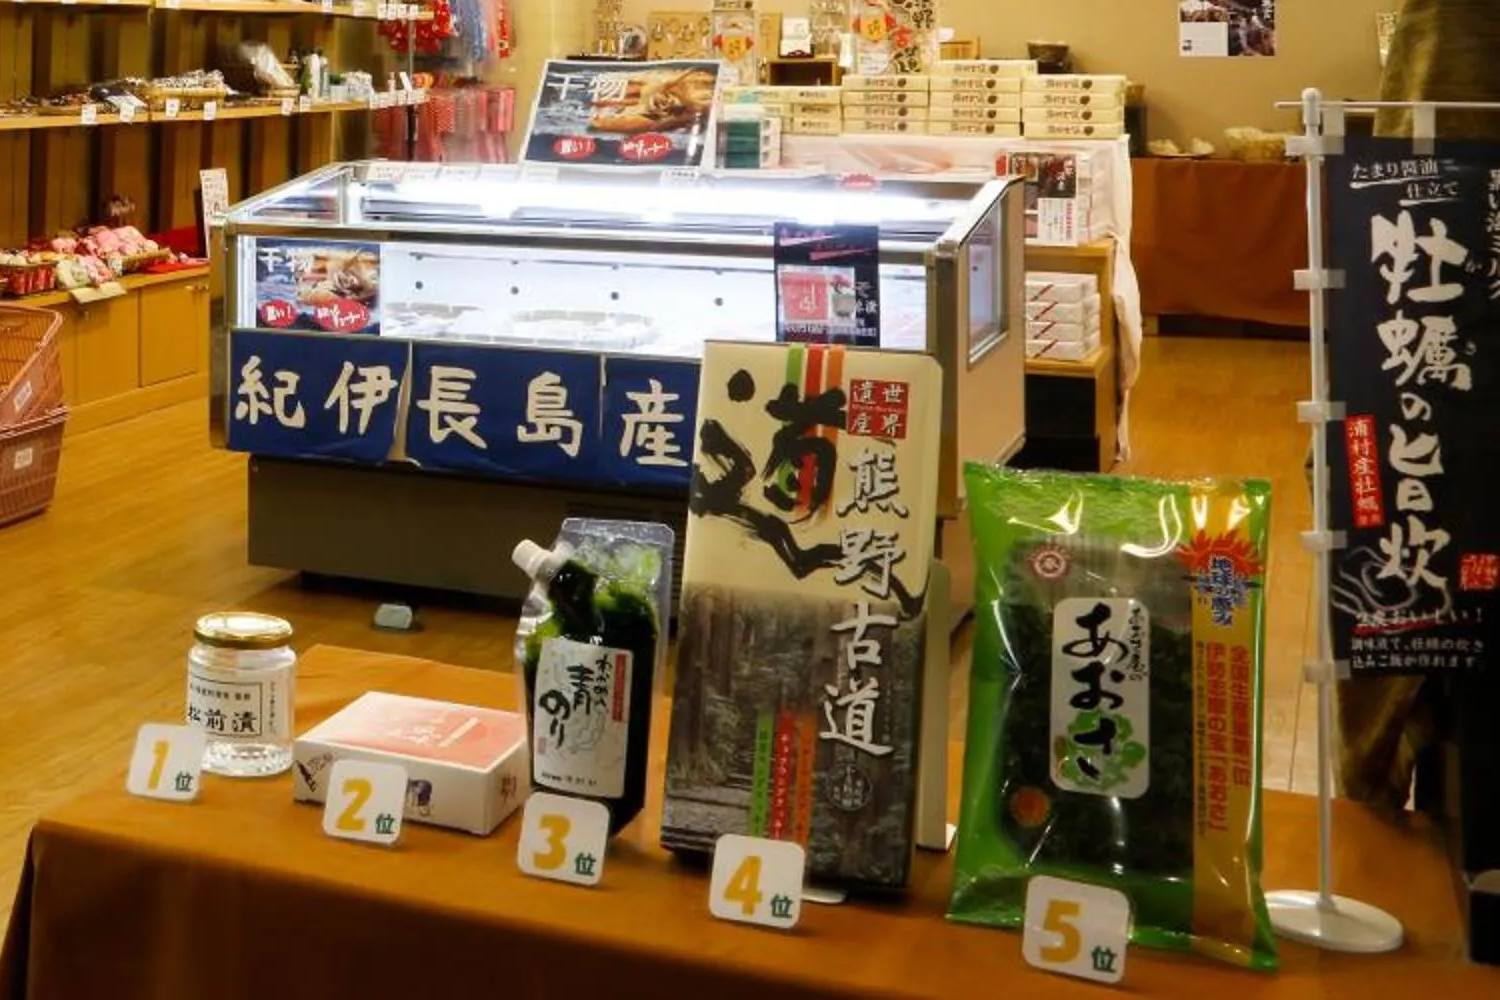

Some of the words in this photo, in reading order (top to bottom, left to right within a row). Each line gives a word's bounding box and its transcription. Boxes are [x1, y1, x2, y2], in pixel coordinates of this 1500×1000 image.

[546, 72, 629, 101] 干物
[1352, 158, 1439, 180] たまり醤油
[233, 354, 690, 469] 紀伊長島産
[818, 449, 910, 756] 熊野古道
[187, 704, 258, 734] 松前漬
[538, 663, 596, 750] 青のり
[1061, 601, 1129, 781] あおさ
[147, 739, 194, 792] 1位
[335, 776, 396, 836] 2位
[532, 813, 598, 877] 3位
[723, 854, 794, 918] 4位
[1038, 898, 1118, 975] 5位
